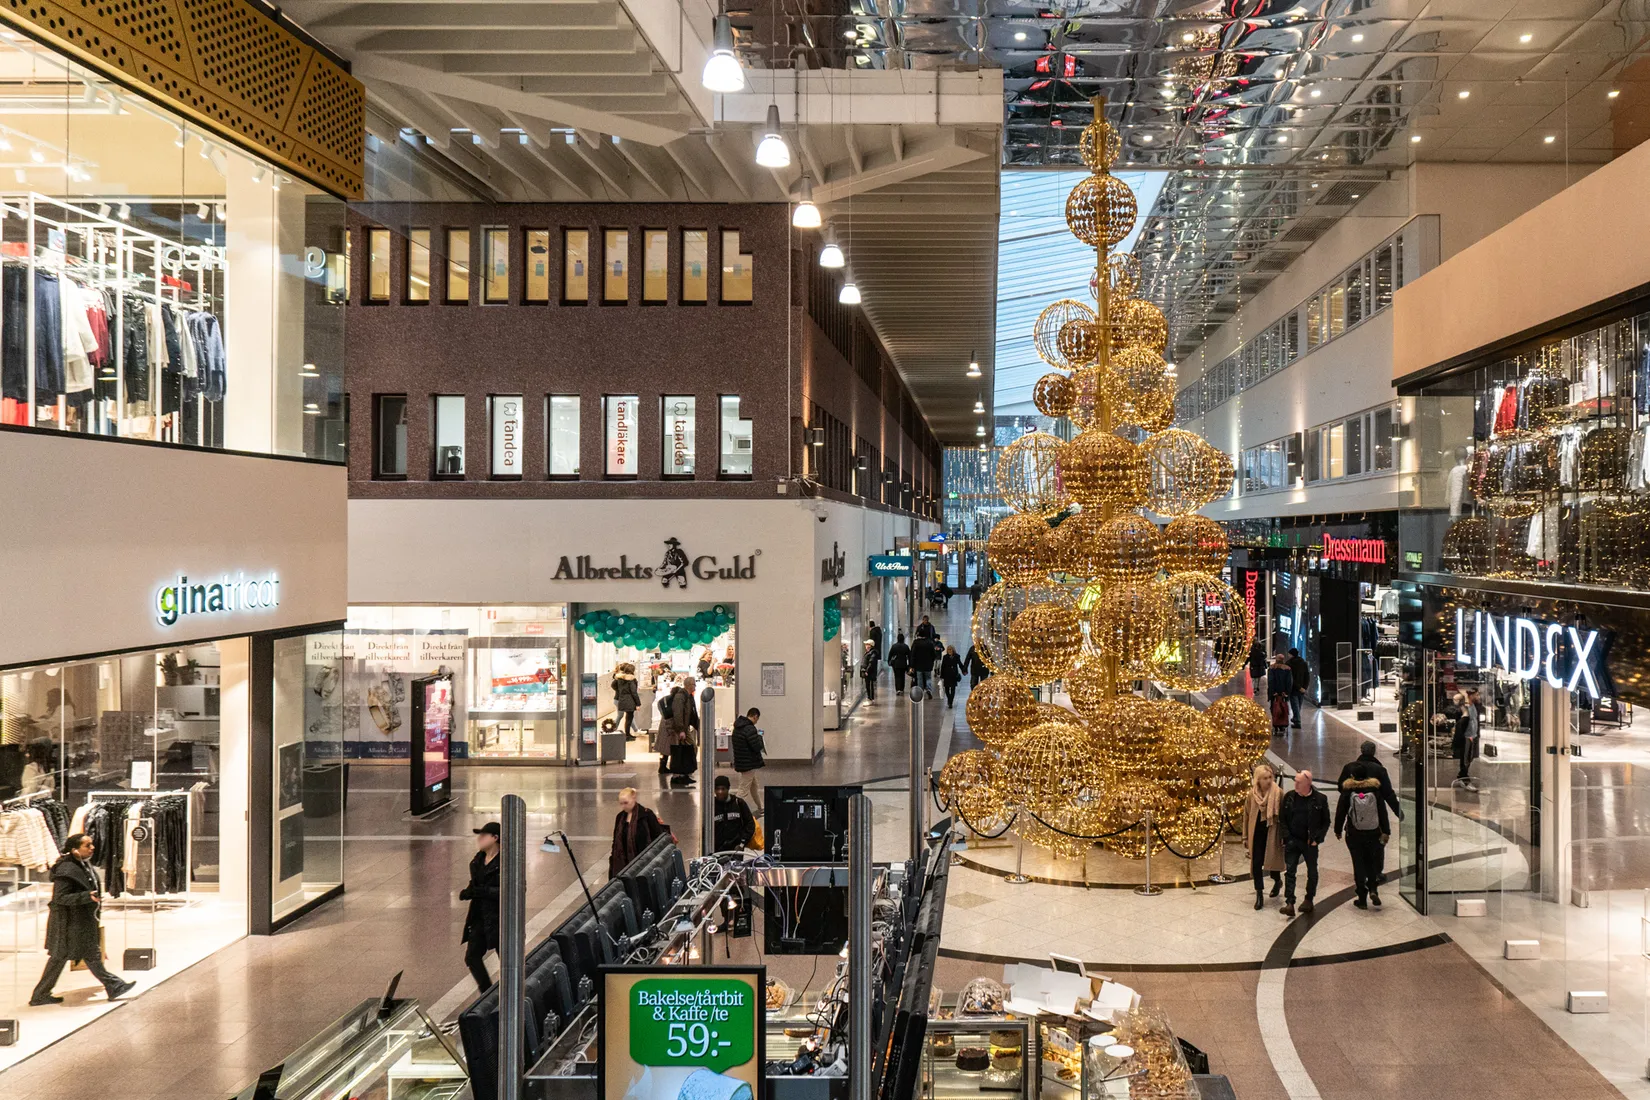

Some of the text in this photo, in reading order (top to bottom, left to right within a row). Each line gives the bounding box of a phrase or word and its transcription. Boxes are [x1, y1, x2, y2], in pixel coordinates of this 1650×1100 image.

[504, 419, 518, 467] tandea
[616, 401, 628, 466] tandläkare
[674, 419, 689, 467] tandea
[1323, 532, 1386, 564] Dressmann
[550, 554, 757, 580] Albrekts Guld
[365, 652, 410, 661] tillverkaren!
[368, 641, 392, 650] Direkt
[420, 652, 465, 661] tillverkaren!
[422, 641, 463, 650] Direkt från
[1456, 607, 1600, 699] LINDEX
[638, 989, 744, 1007] Bakelse/tårtbit
[652, 1007, 667, 1021] &
[668, 1006, 708, 1021] Kaffe
[666, 1023, 732, 1058] 59:-
